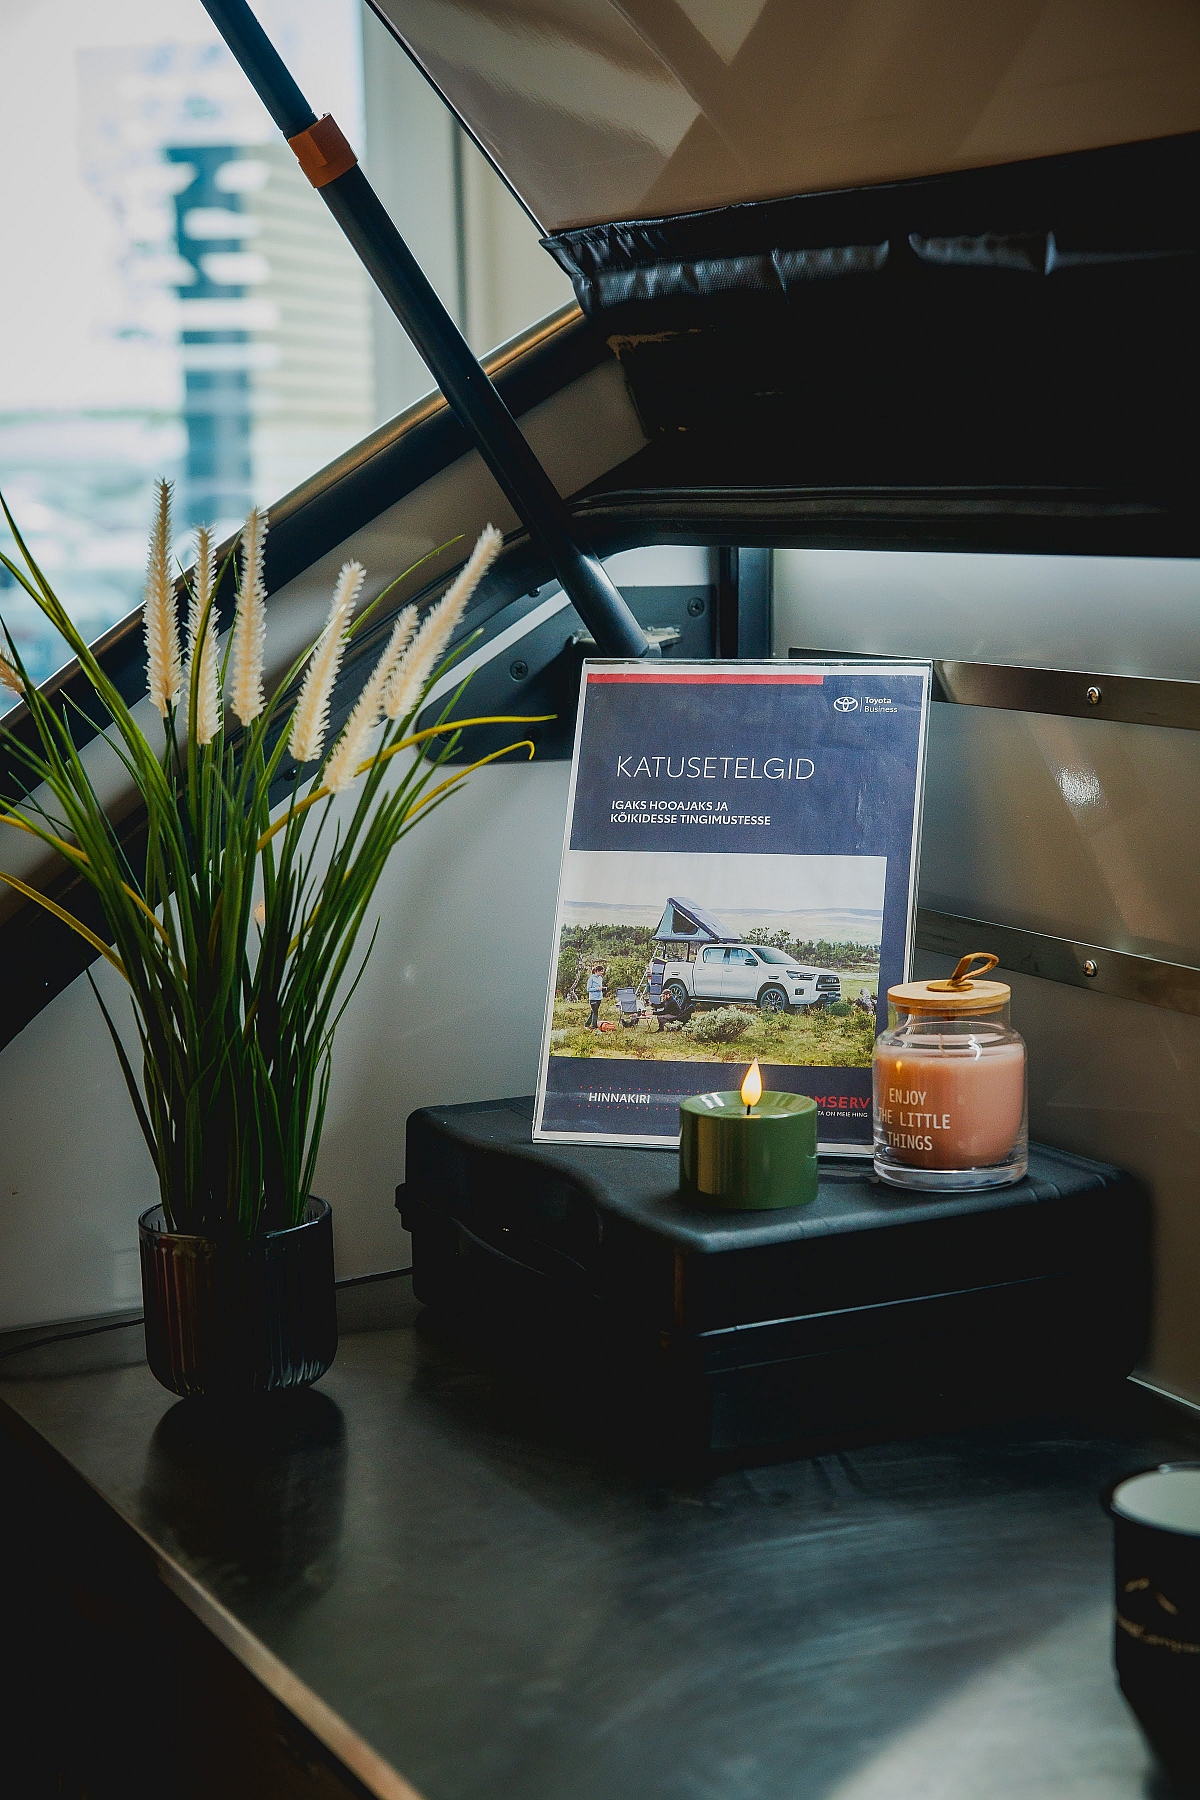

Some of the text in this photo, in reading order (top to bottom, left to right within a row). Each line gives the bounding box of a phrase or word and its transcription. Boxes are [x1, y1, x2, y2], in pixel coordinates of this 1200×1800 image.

[864, 696, 892, 705] Toyota
[864, 705, 898, 713] Business
[616, 755, 815, 780] KATUSETELGID
[611, 800, 729, 812] IGAKS HOOAJAKS JA
[610, 812, 771, 826] KÕIKIDESSE TINGIMUSTESSE
[588, 1092, 651, 1104] HINNAKIRI
[806, 1095, 871, 1109] MSERV
[889, 1087, 927, 1106] ENJOY
[900, 1111, 951, 1130] LITTLE
[886, 1131, 933, 1151] THINGS
